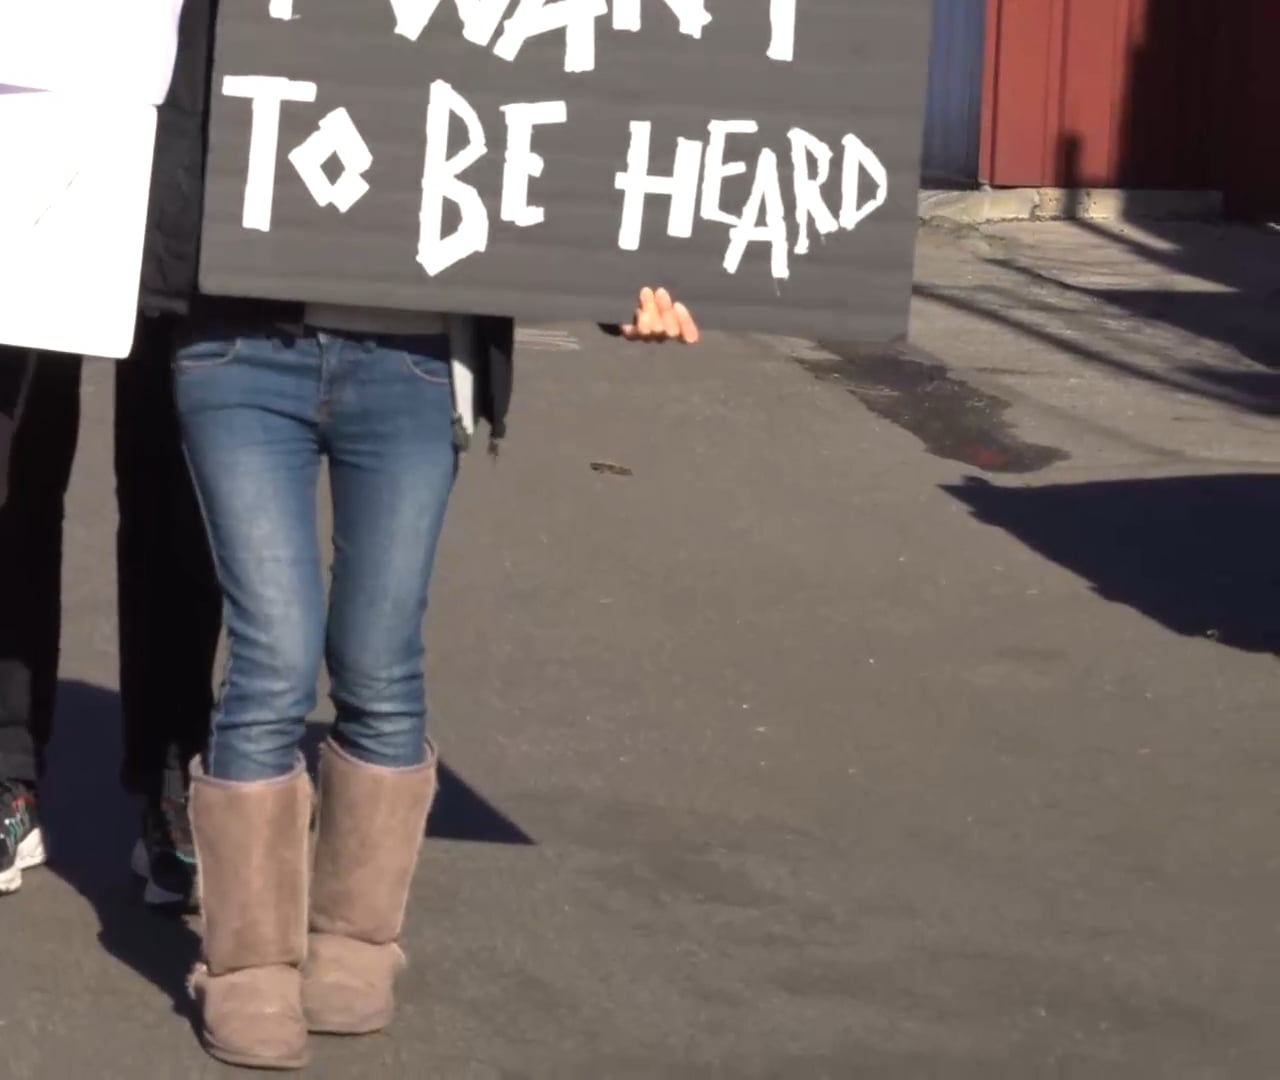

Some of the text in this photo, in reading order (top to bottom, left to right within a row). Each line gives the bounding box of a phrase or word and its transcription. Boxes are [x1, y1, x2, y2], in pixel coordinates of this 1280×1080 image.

[222, 75, 887, 279] TO BE HEARD
